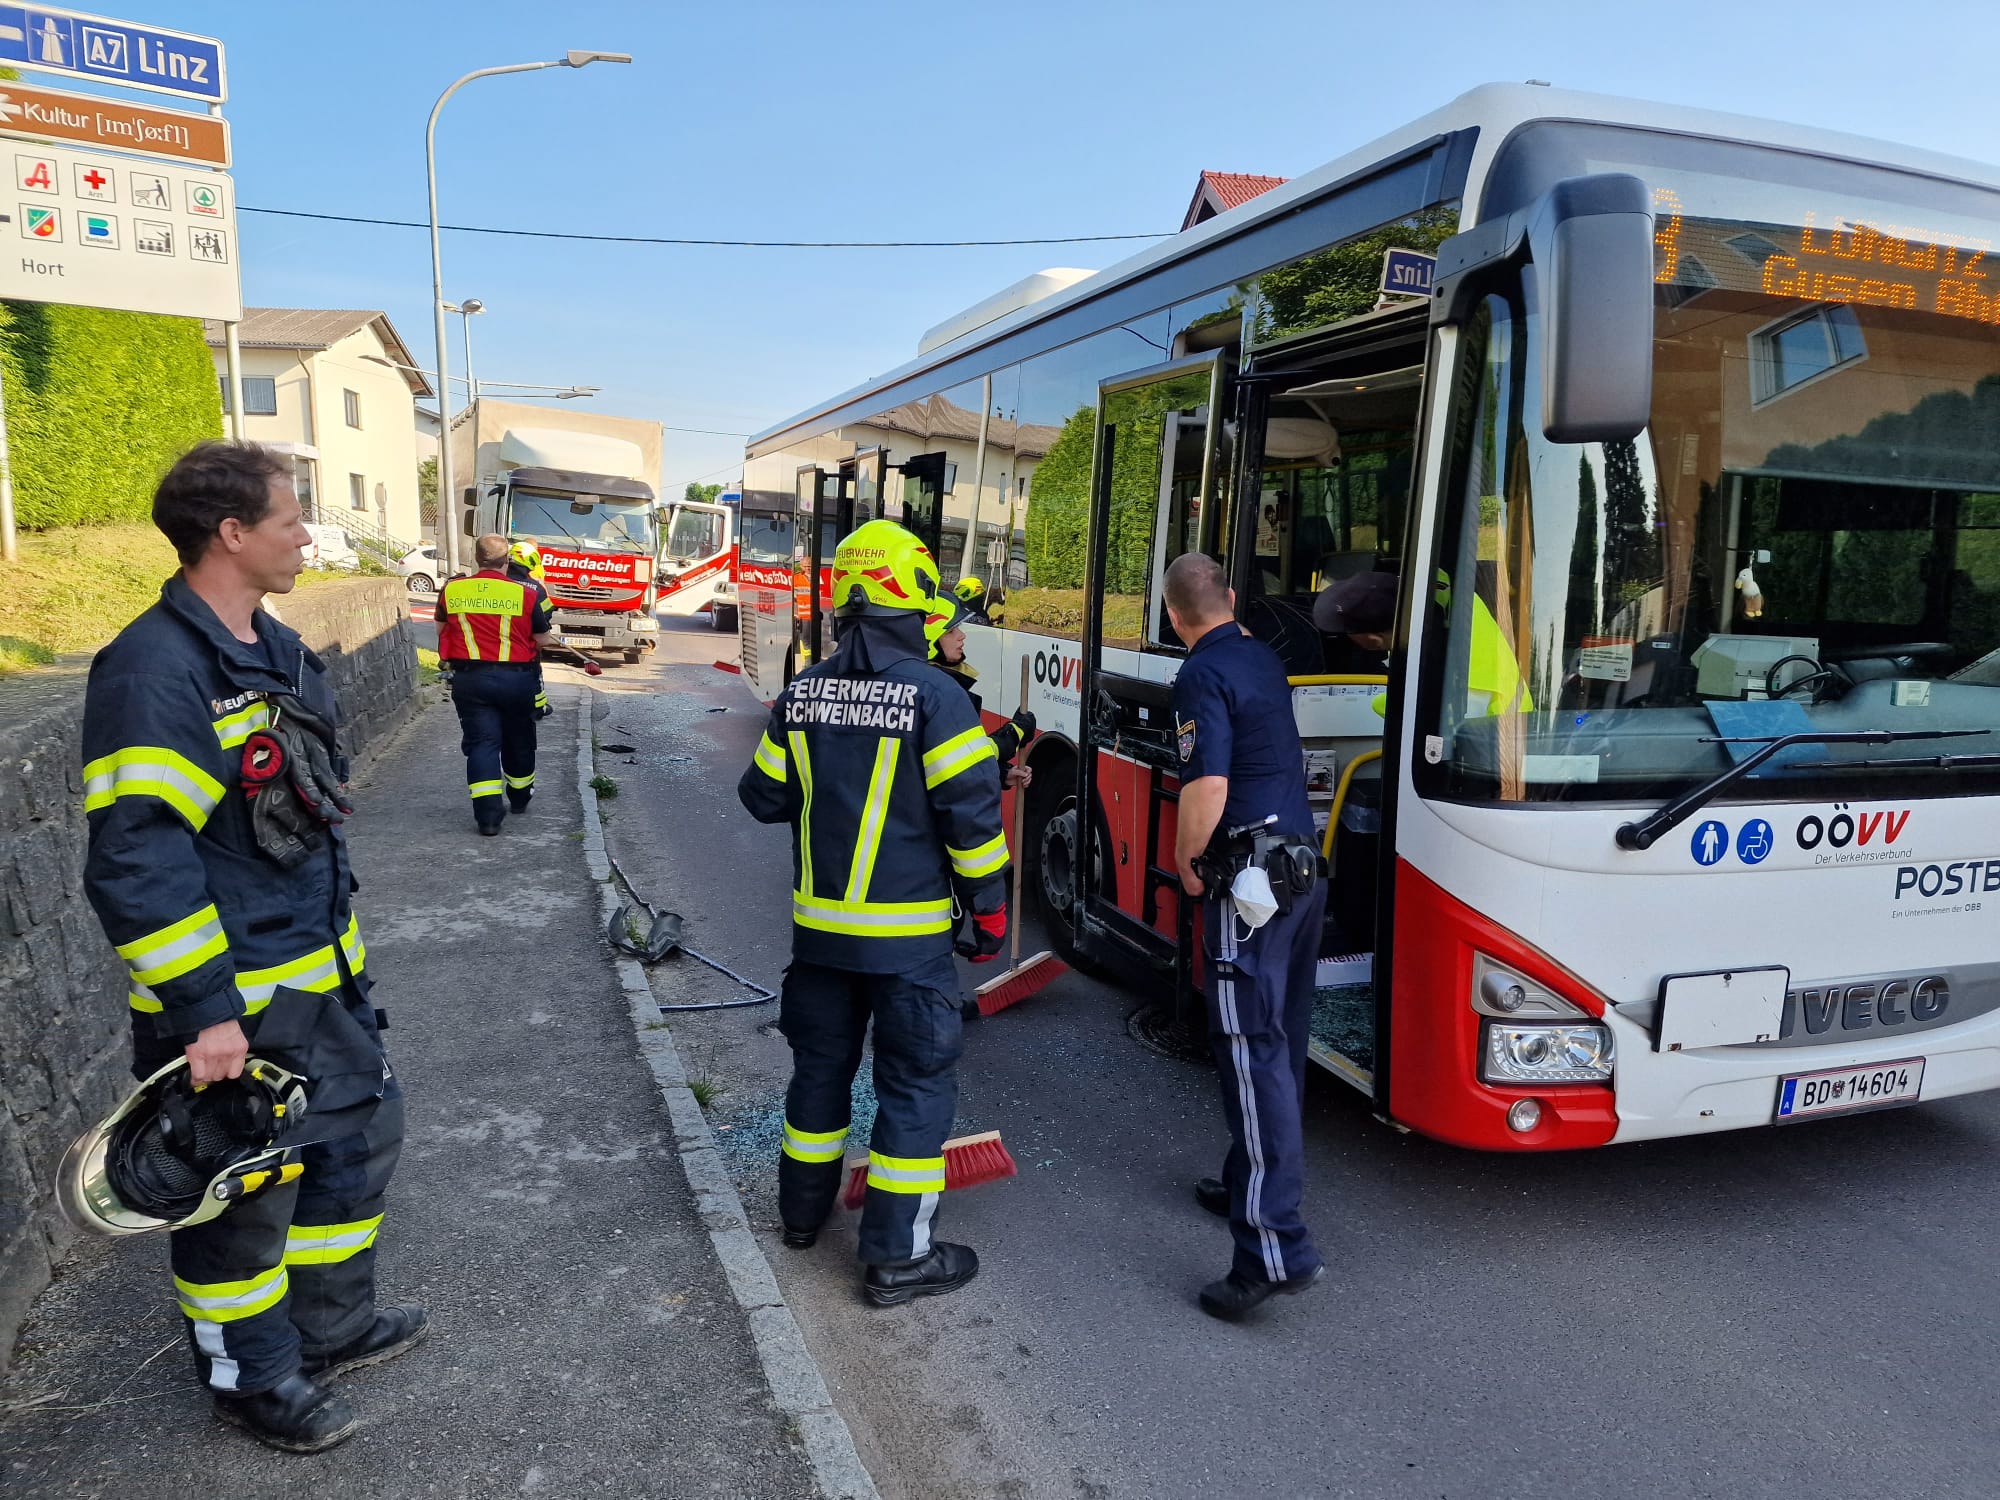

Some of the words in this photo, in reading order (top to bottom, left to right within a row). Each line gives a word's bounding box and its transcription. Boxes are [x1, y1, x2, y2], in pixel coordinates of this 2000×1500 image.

[91, 36, 121, 65] A7
[138, 37, 209, 84] Linz
[23, 101, 90, 129] Kultur
[22, 257, 65, 277] Hort
[541, 553, 631, 573] Brandacher
[448, 597, 519, 611] SCHWEINBACH
[1796, 803, 1911, 850] OÖVV
[1815, 853, 1832, 865] Der
[1835, 848, 1913, 863] Verkehrsverbund
[1895, 859, 2000, 900] POSTB
[1892, 910, 1903, 919] Ein
[1904, 904, 1950, 918] Unternehmen
[1951, 903, 1963, 913] der
[1781, 975, 1950, 1040] IVECO
[1783, 1101, 1790, 1110] A
[1803, 1079, 1831, 1107] BD
[1849, 1068, 1908, 1099] 14604
